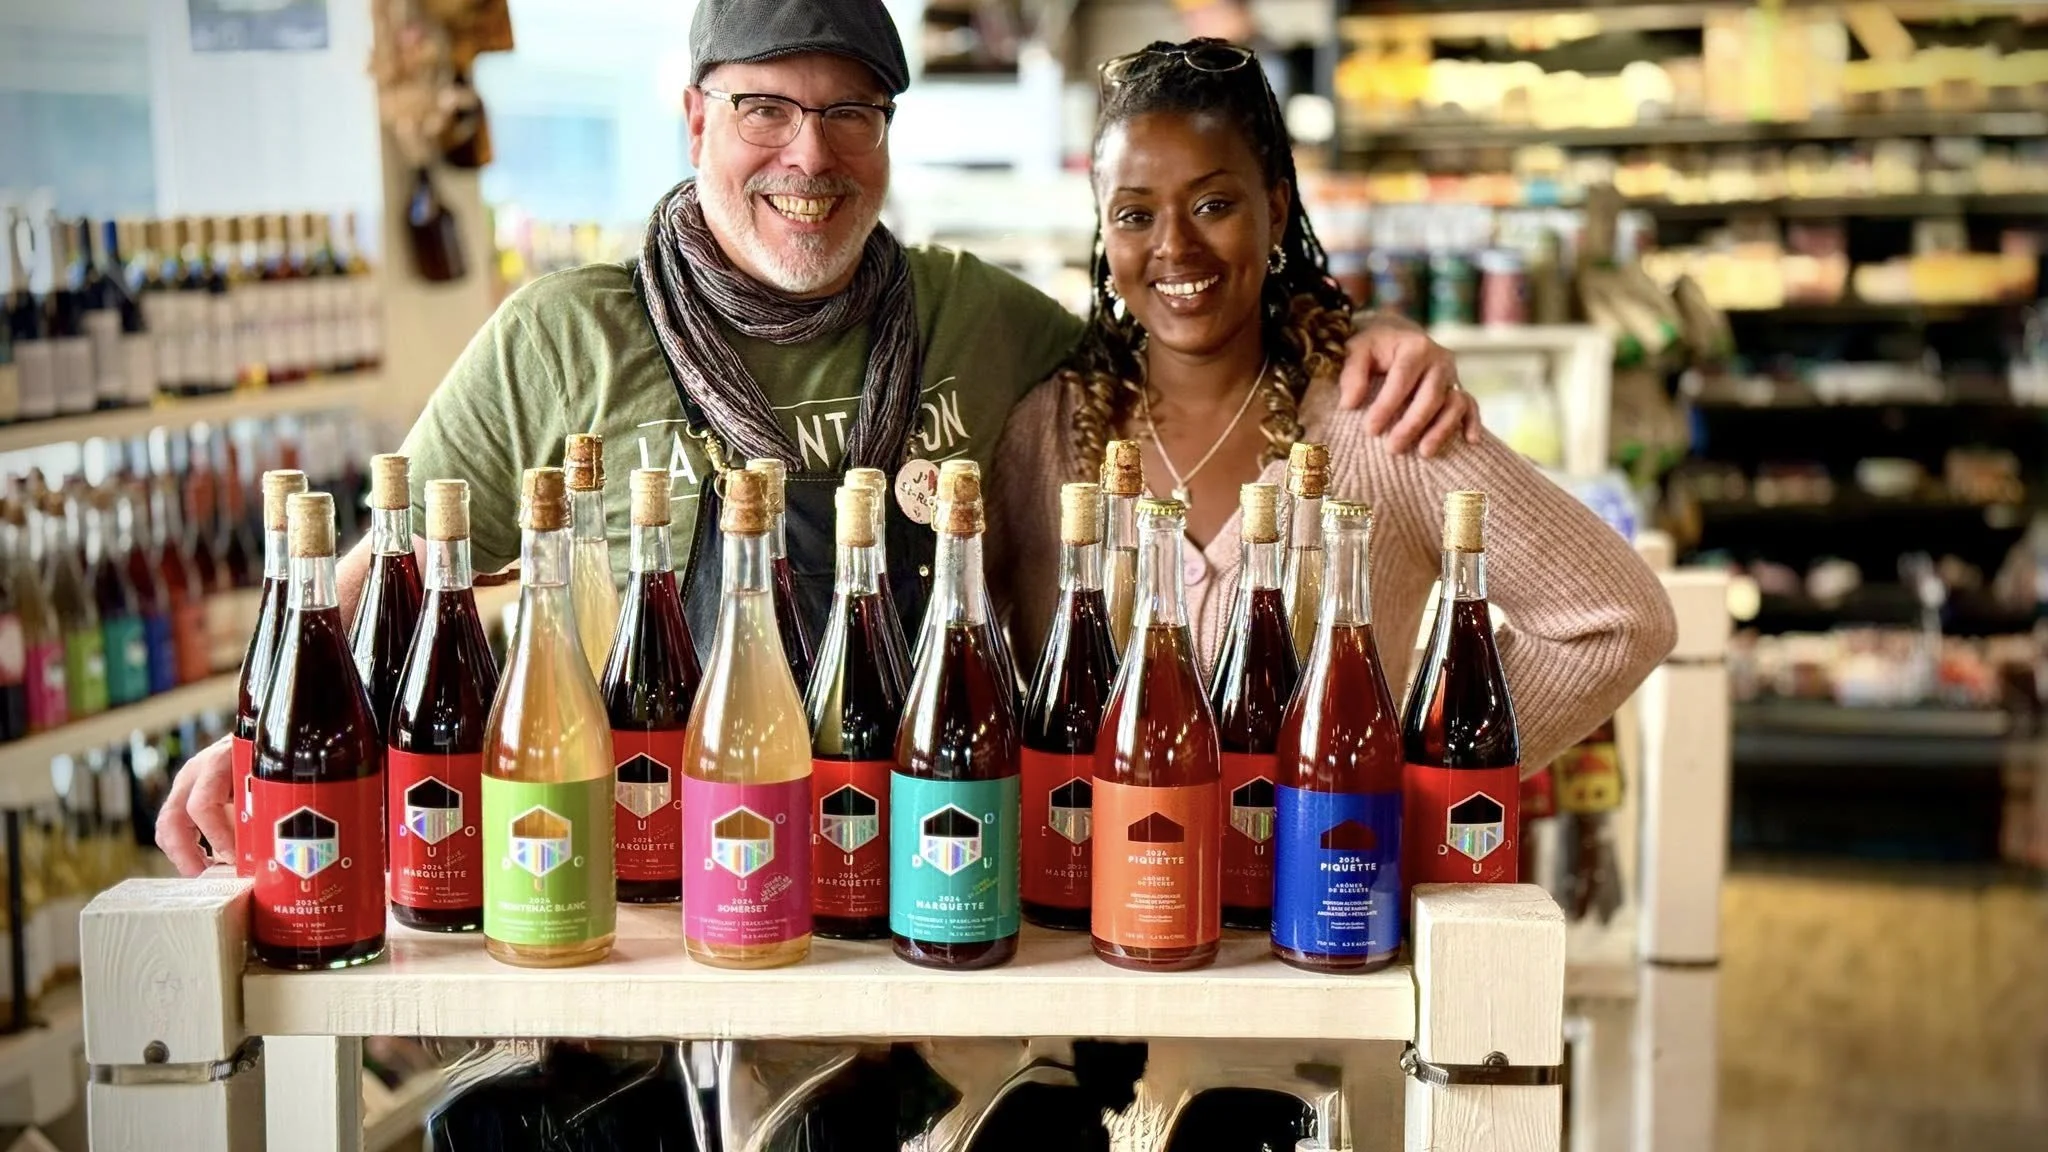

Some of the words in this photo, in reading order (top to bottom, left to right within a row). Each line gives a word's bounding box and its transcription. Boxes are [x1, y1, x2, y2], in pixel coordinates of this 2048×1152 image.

[427, 847, 436, 857] U
[465, 826, 476, 837] O
[844, 855, 853, 865] U
[1128, 856, 1184, 864] PIQUETTE
[403, 867, 466, 878] MARQUETTE
[1320, 863, 1376, 872] PIQUETTE
[1473, 863, 1482, 874] U
[301, 880, 310, 892] U
[341, 857, 352, 868] O
[1046, 869, 1088, 877] MARQUE
[817, 877, 881, 887] MARQUETTE
[274, 905, 343, 914] MARQUETTE
[555, 901, 586, 911] BLANC
[718, 905, 768, 913] SOMERSET
[916, 900, 984, 910] MARQUETTE
